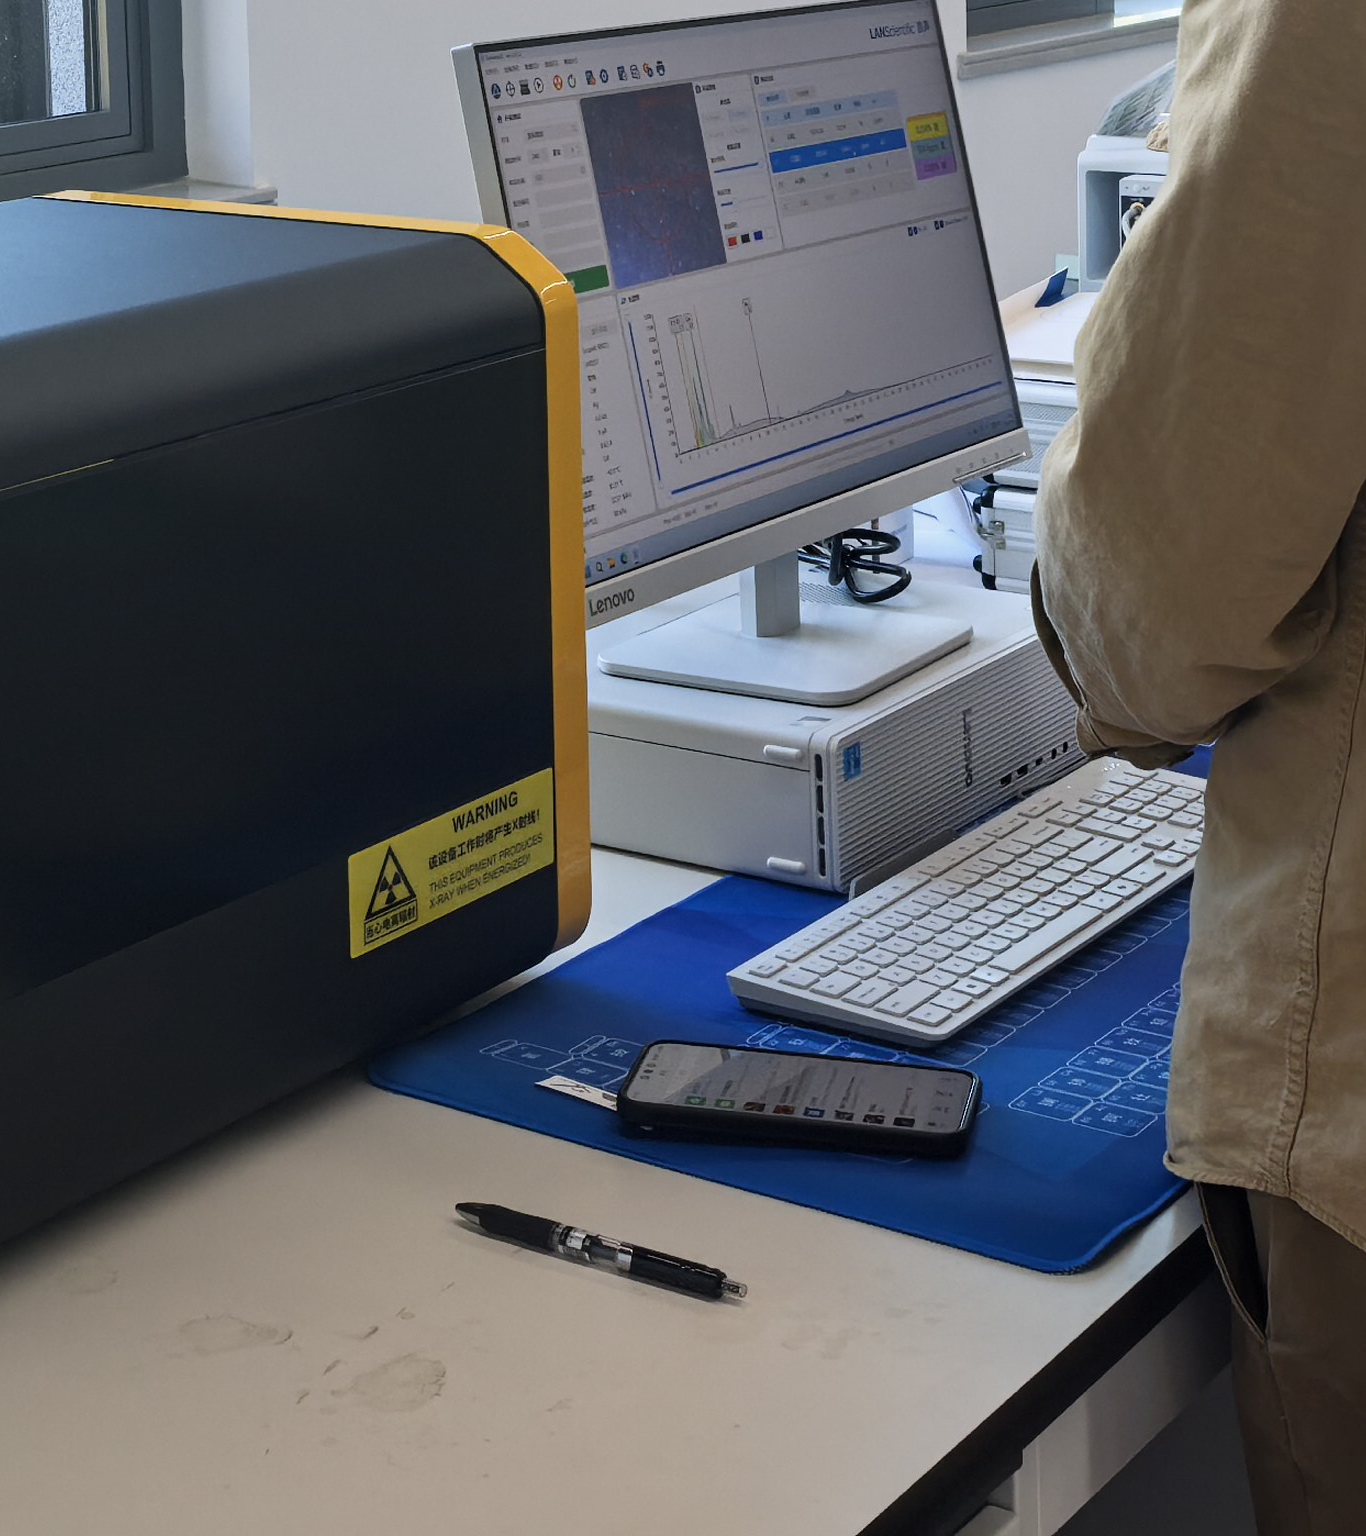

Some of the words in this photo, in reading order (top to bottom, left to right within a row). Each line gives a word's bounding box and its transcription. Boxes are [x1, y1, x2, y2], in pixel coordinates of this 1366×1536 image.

[588, 588, 635, 617] Lenovo
[451, 791, 519, 833] WARNING
[429, 875, 449, 894] THIS
[450, 854, 497, 882] EQUIPMENT
[499, 832, 544, 861] PRODUCES
[429, 888, 455, 909] X-RAY
[456, 877, 482, 897] WHEN
